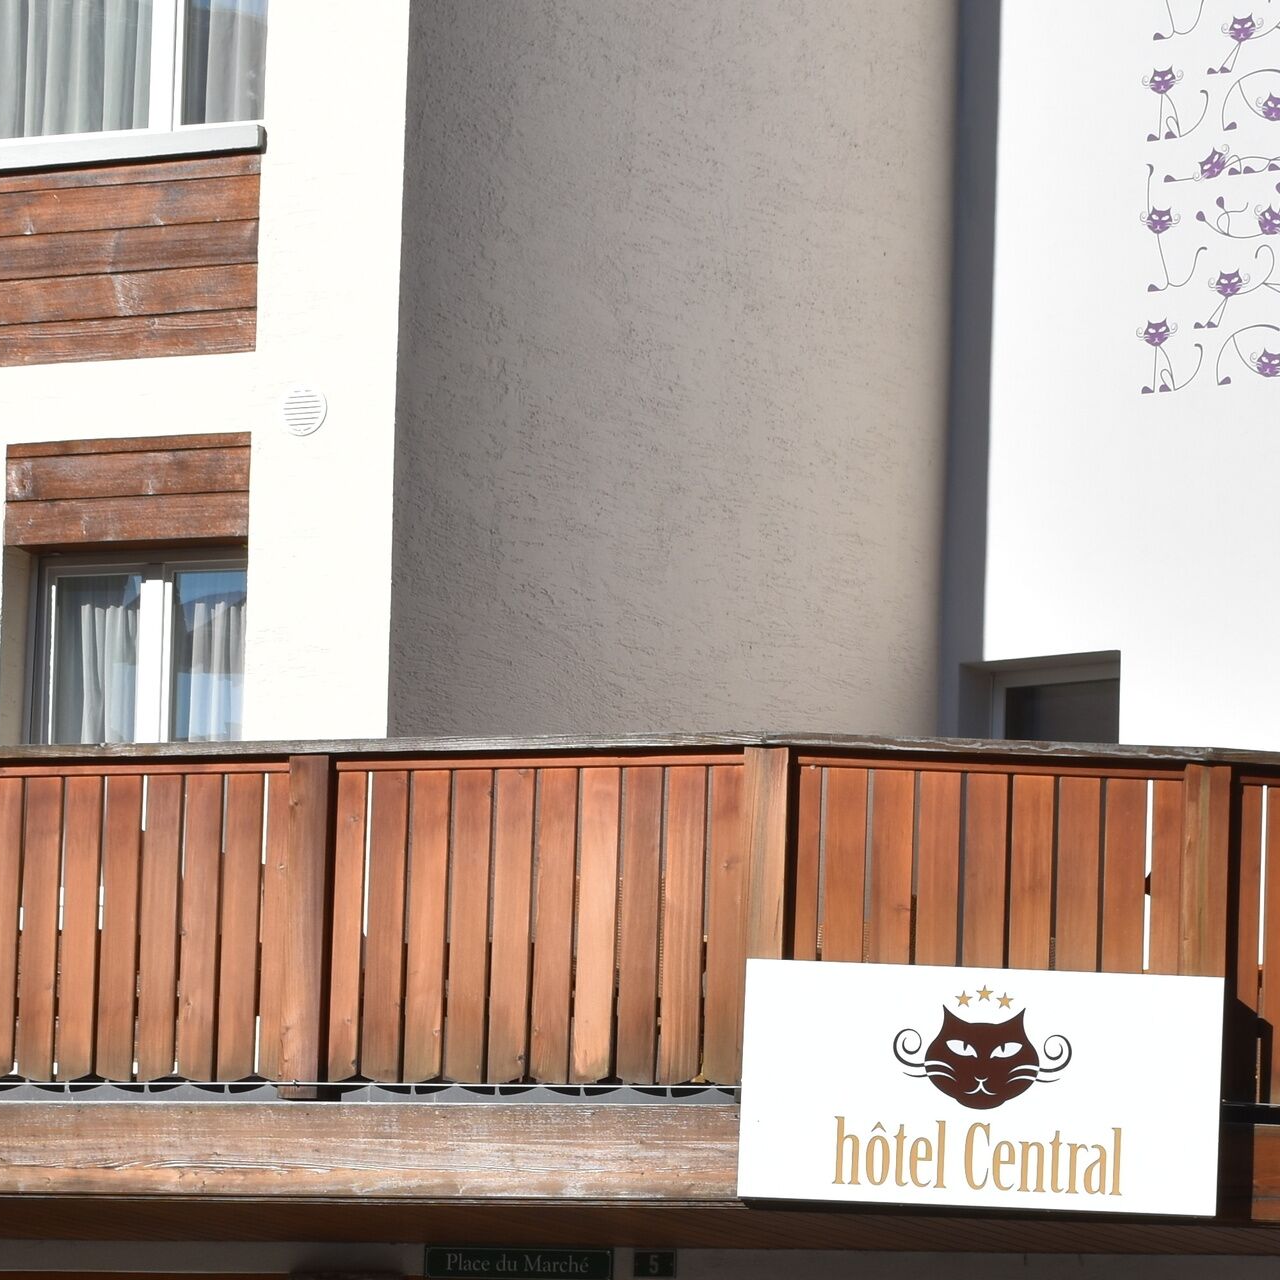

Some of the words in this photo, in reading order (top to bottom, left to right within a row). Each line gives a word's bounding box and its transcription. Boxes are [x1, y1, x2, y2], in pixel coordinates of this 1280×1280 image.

[832, 1116, 947, 1191] hôtel
[964, 1122, 1123, 1196] Central
[446, 1253, 490, 1272] Place
[496, 1254, 518, 1271] du
[524, 1254, 589, 1273] Marché
[649, 1255, 659, 1274] 5
